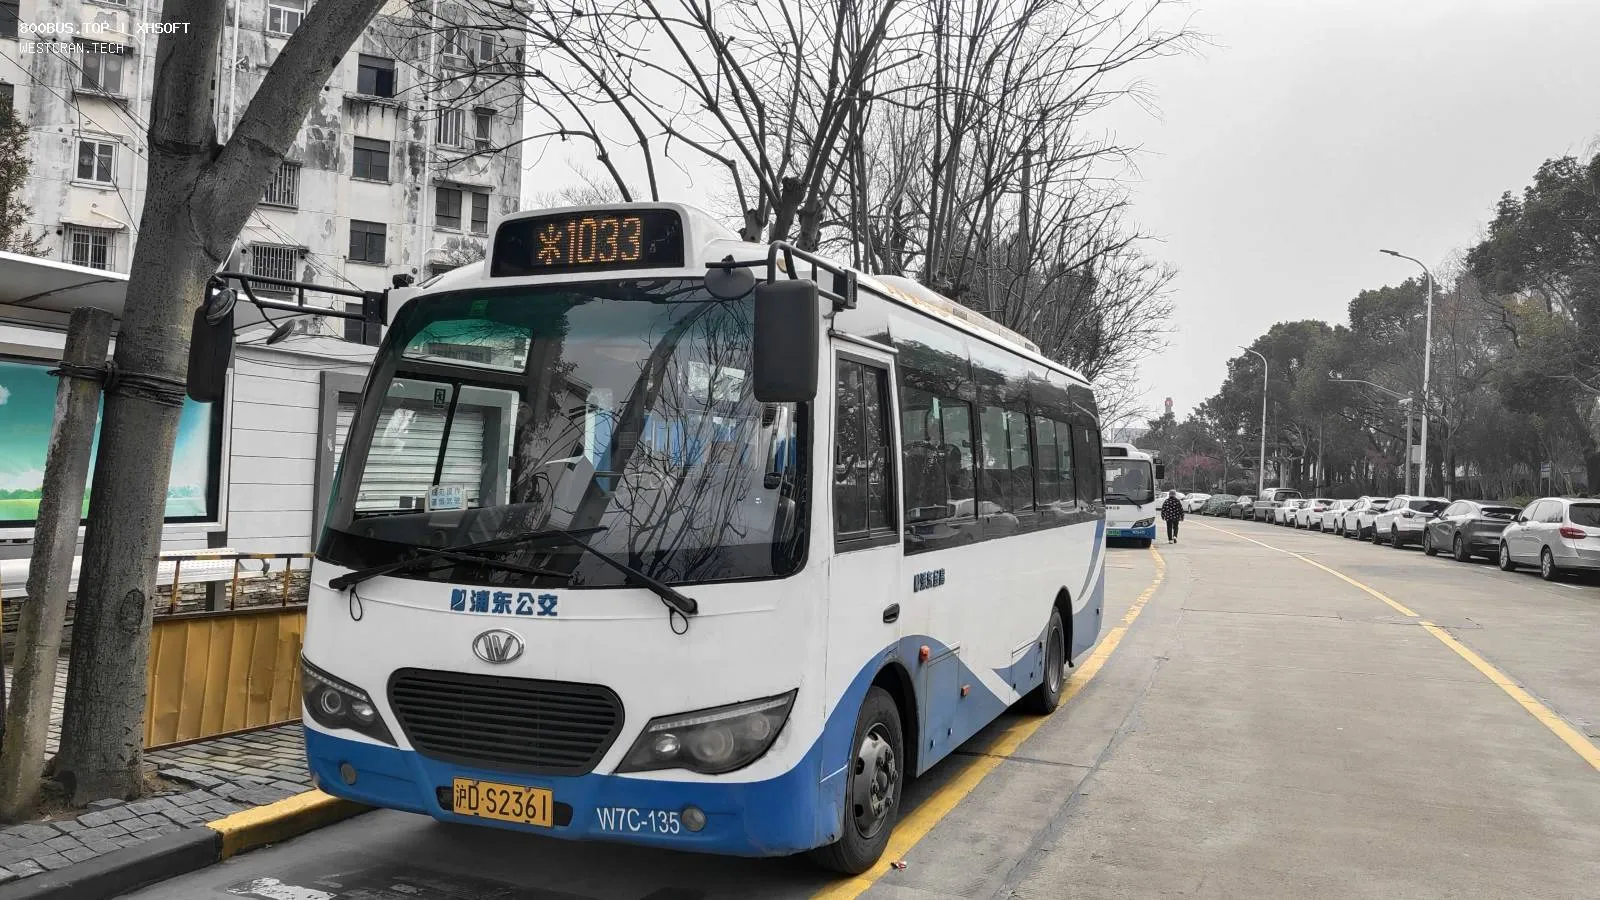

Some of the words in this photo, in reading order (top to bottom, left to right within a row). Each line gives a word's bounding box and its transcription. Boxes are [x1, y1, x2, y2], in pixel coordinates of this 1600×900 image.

[469, 589, 558, 617] 浦东公交
[596, 807, 680, 835] W7C-135
